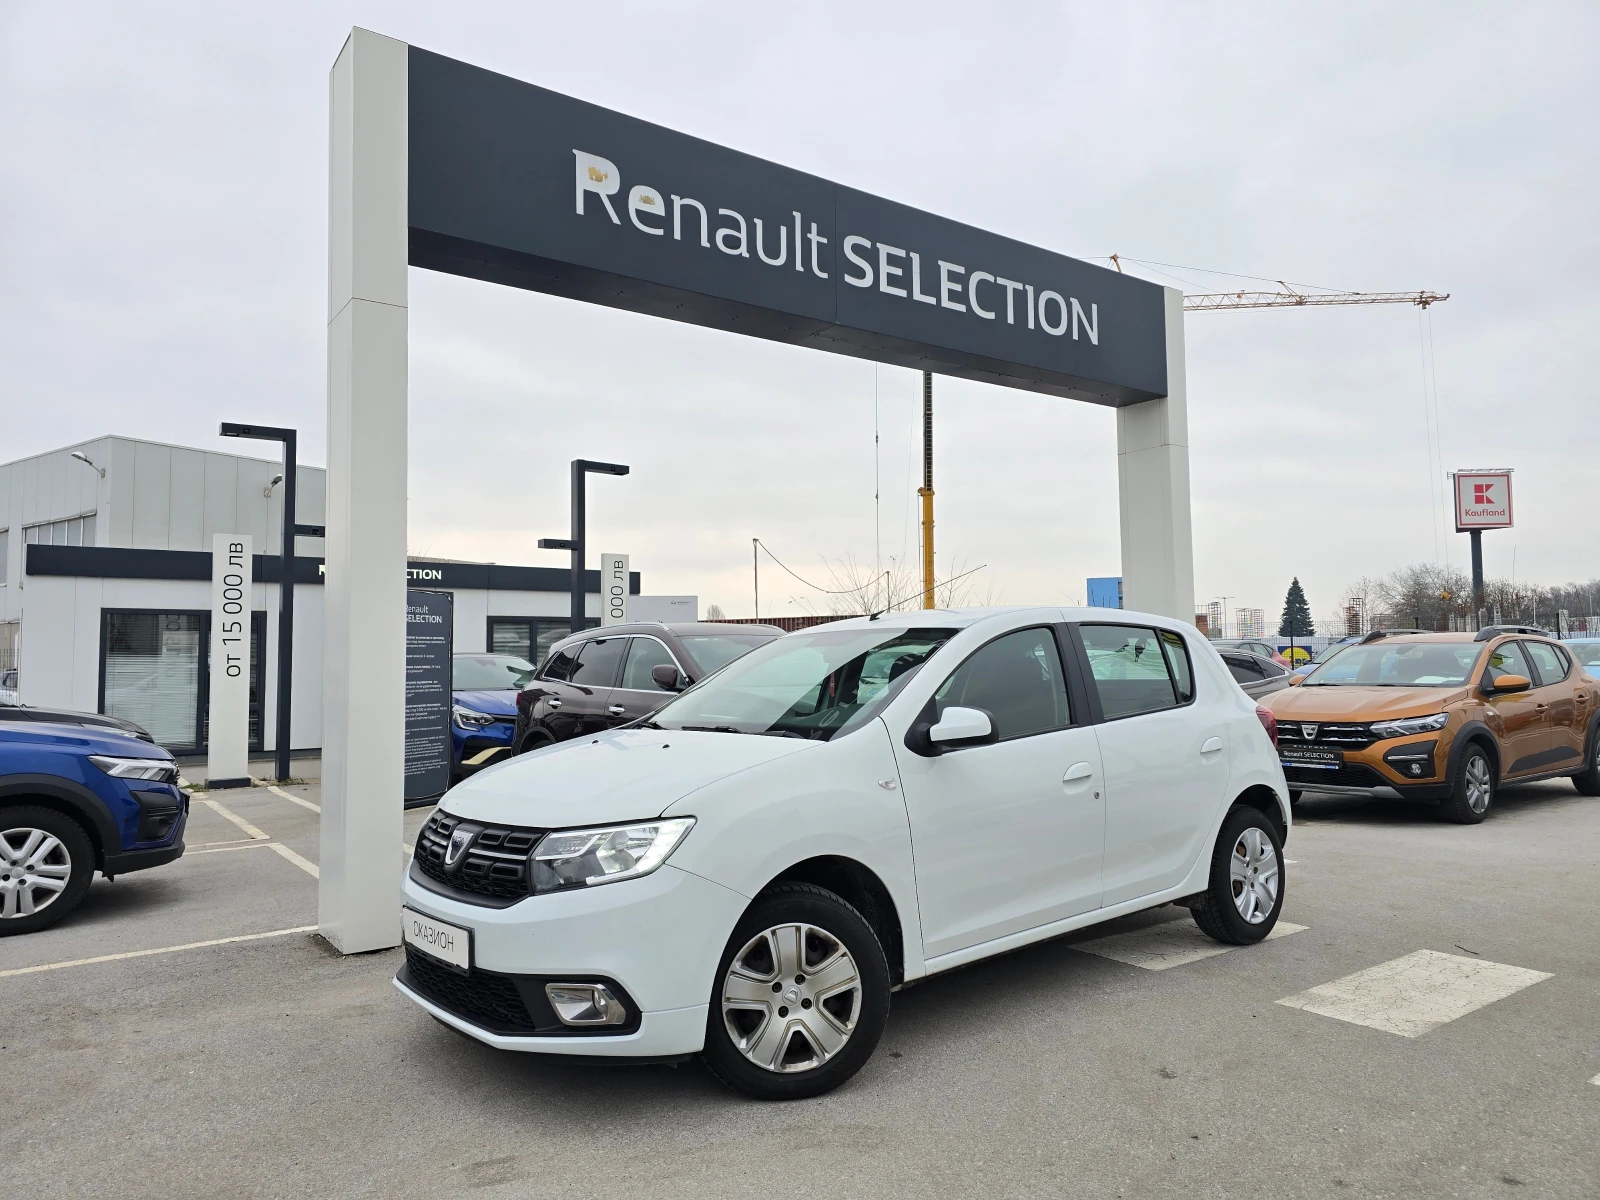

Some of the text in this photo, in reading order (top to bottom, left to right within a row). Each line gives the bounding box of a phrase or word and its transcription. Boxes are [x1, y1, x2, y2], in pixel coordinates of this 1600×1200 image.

[572, 149, 1099, 346] Renault SELECTION
[1465, 508, 1506, 517] Kaufland
[222, 575, 242, 614] 000
[611, 586, 624, 619] 000
[222, 621, 242, 646] 15
[413, 920, 454, 952] ОКАЗИОН
